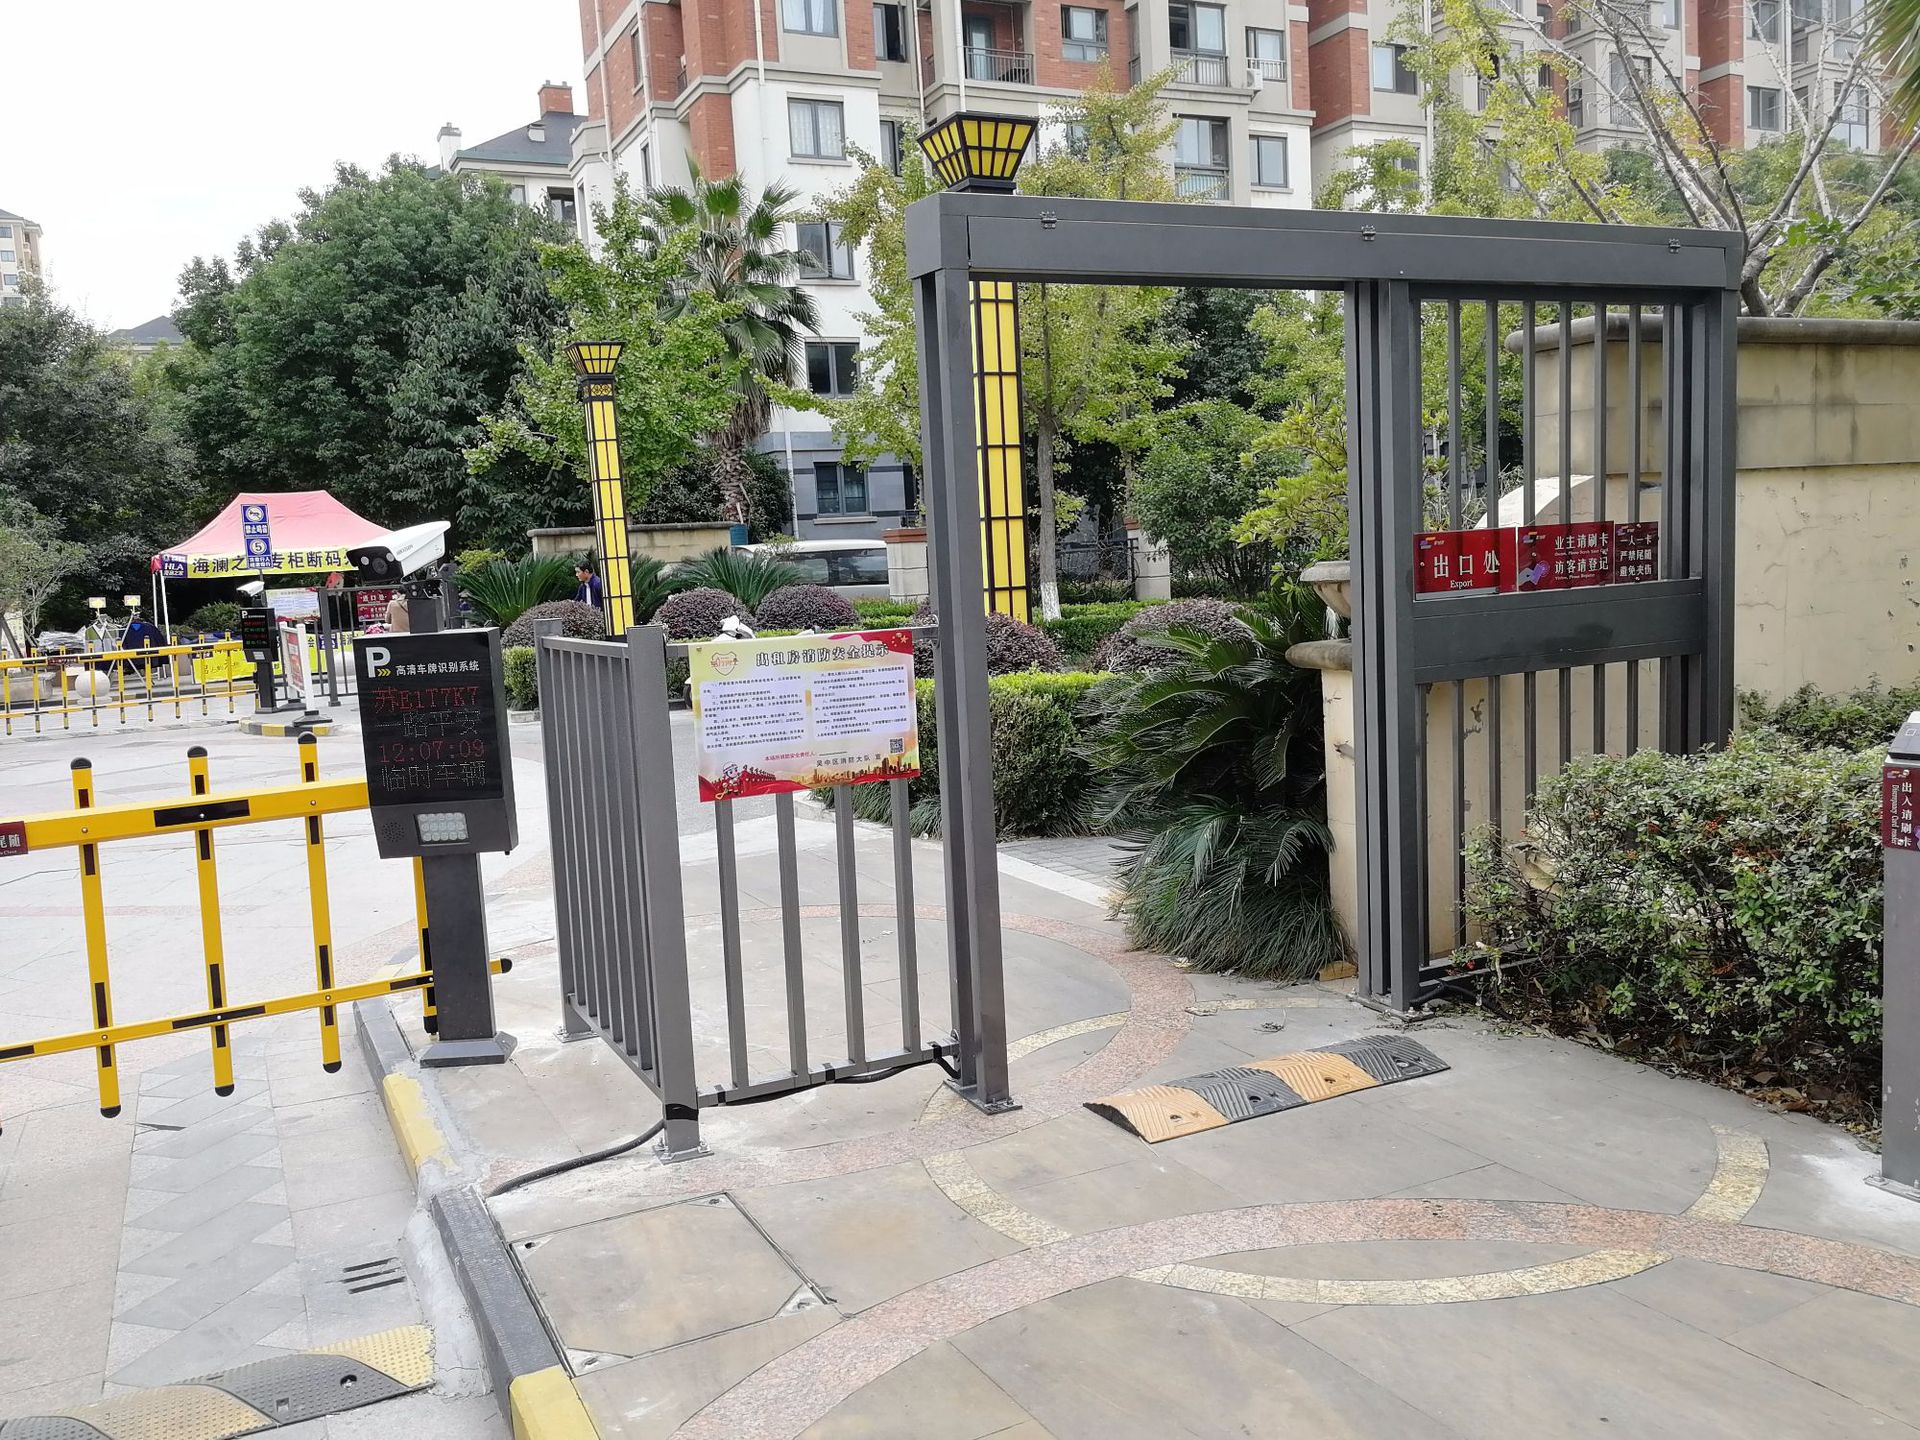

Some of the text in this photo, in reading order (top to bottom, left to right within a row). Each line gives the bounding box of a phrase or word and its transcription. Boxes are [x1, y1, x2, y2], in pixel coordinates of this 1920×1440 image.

[255, 542, 262, 551] 5
[1555, 532, 1609, 550] 业主请刷卡
[1620, 533, 1653, 546] 一人一卡
[1433, 550, 1501, 579] 出口处
[1619, 549, 1652, 562] 严禁尾随
[164, 562, 184, 571] HLA
[1555, 556, 1609, 574] 访客请登记
[1450, 579, 1473, 590] Export
[365, 646, 391, 678] P
[755, 643, 889, 667] 出租房消防安全提示
[395, 660, 480, 677] 高清车牌识别系统
[375, 708, 481, 739] 一路平安
[378, 739, 486, 763] 12:07:09
[381, 760, 486, 792] 临时车辆
[1901, 782, 1912, 847] 出入请刷卡
